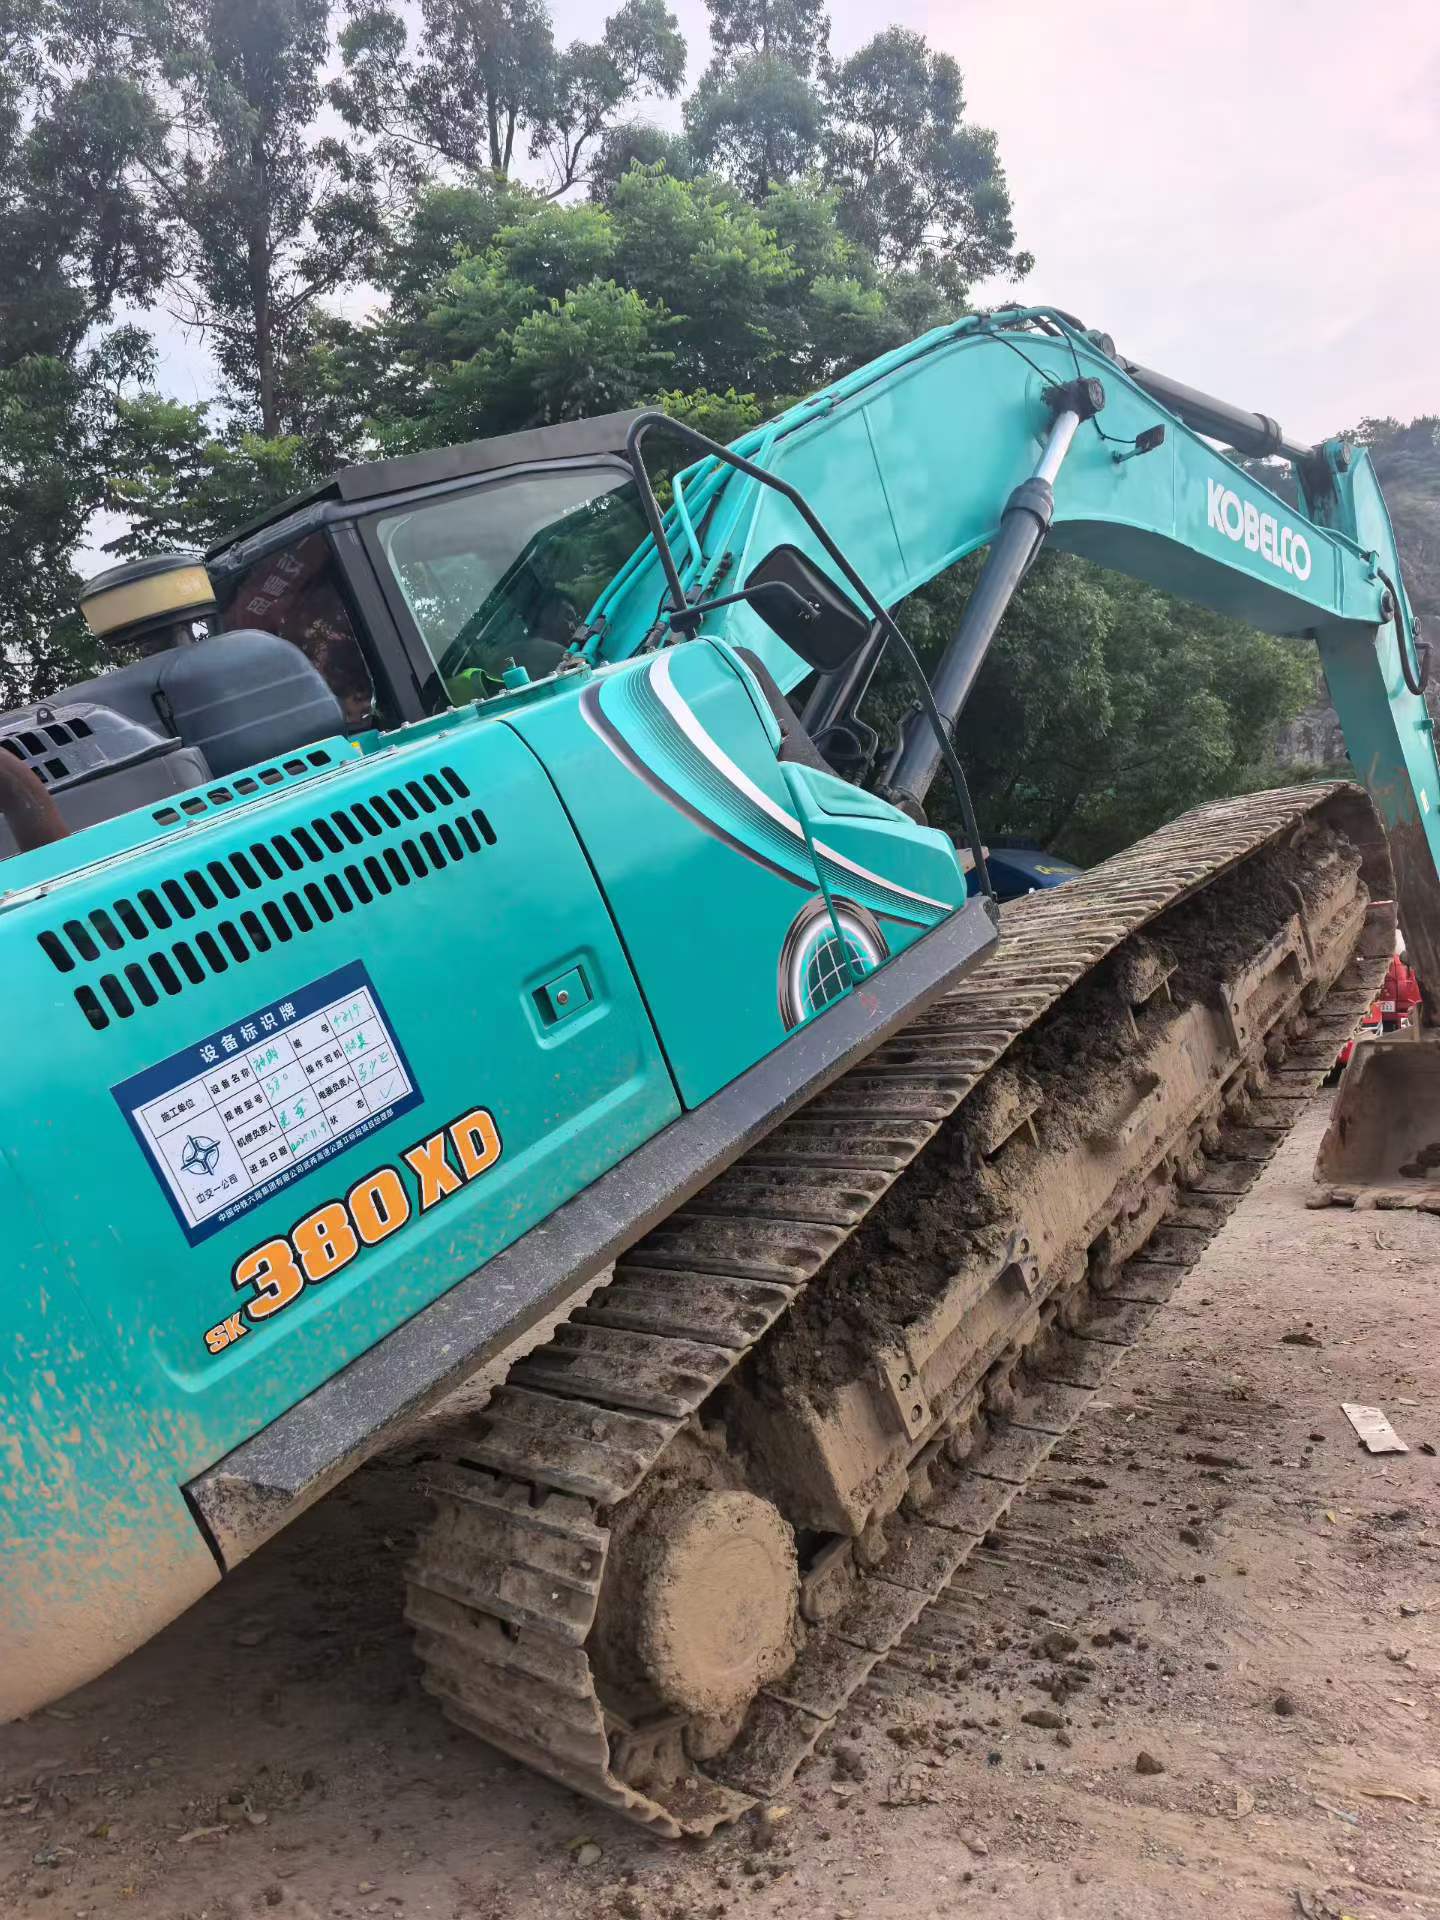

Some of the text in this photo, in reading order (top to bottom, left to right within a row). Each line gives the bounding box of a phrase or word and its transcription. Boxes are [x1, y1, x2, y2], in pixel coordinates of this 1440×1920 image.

[1207, 477, 1312, 581] KOBELCO
[199, 1001, 297, 1064] 设备标识牌
[306, 1049, 343, 1075] 操作司机
[210, 1067, 251, 1095] 设备名称
[160, 1098, 195, 1123] 施工单位
[224, 1093, 263, 1122] 规格型号
[236, 1120, 276, 1148] 机修负责人
[249, 1145, 288, 1174] 进场日期
